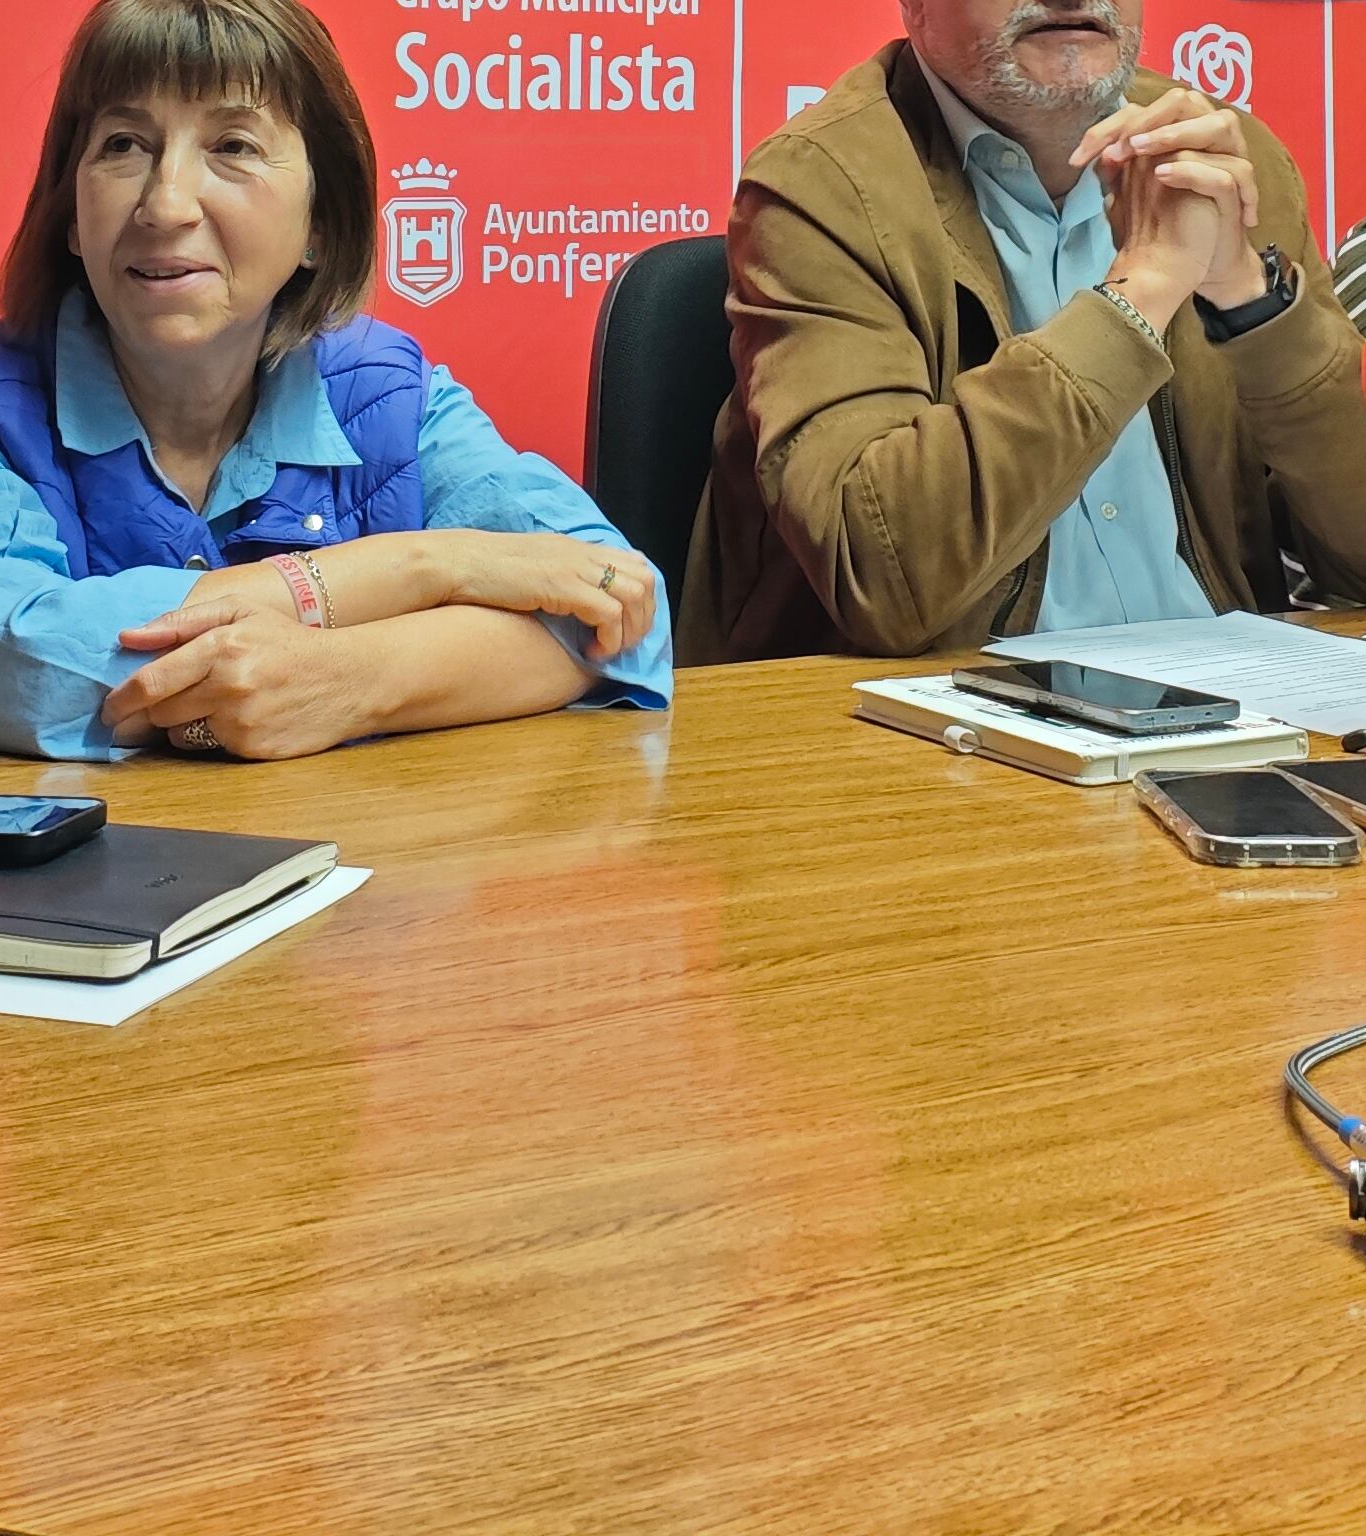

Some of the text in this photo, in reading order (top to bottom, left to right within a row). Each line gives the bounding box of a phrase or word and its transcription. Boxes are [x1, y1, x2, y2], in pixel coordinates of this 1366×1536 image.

[394, 31, 695, 112] Socialista
[483, 201, 710, 244] Ayuntamiento
[482, 242, 637, 298] Ponfer
